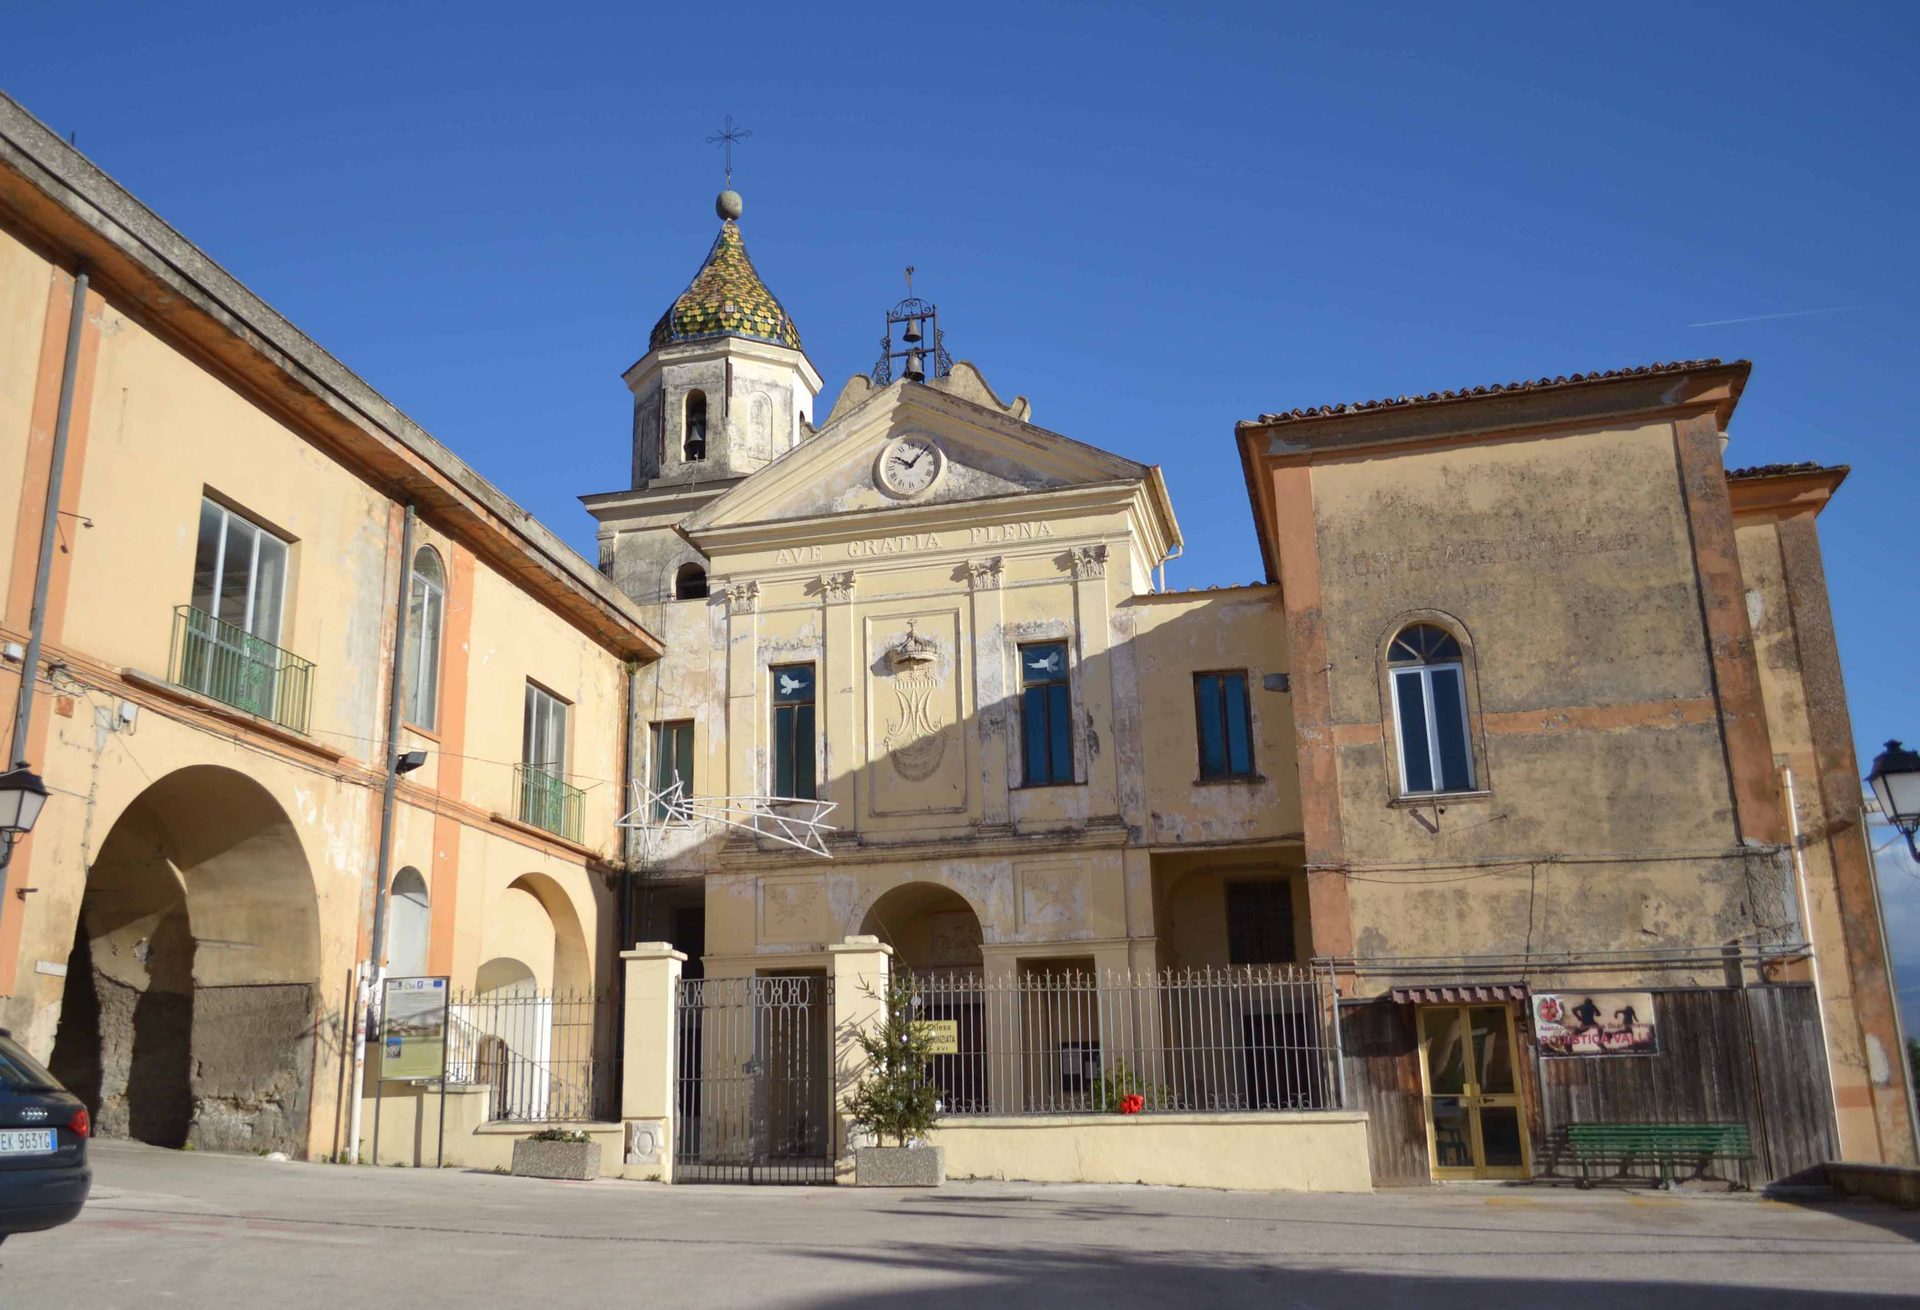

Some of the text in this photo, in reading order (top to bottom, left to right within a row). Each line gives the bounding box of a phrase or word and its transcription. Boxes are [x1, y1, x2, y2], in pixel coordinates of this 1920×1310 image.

[776, 520, 1054, 564] AVE GRATIA PLENA
[1, 1133, 14, 1150] EK
[18, 1132, 50, 1149] 963YG
